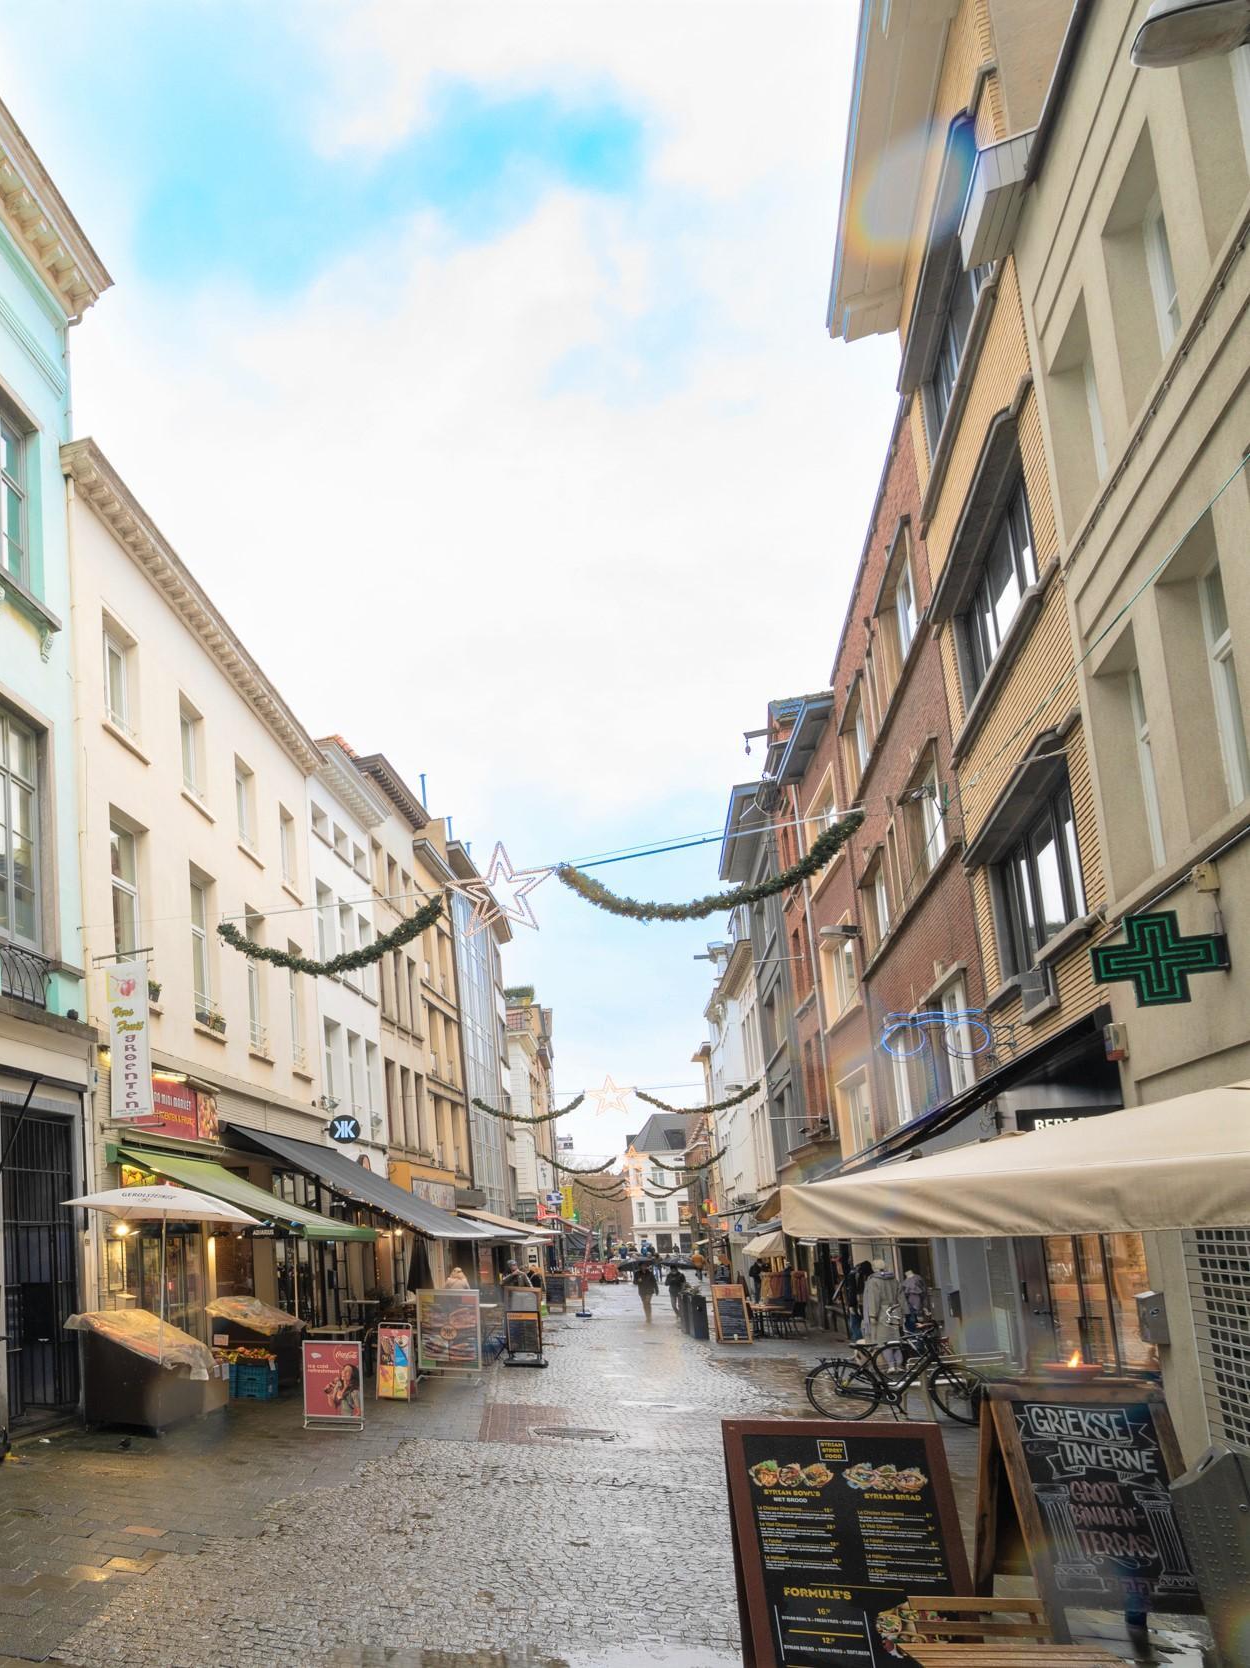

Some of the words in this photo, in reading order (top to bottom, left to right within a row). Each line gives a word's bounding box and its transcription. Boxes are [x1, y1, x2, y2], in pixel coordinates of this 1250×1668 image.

[1059, 1441, 1159, 1474] TAVERNE
[1069, 1480, 1124, 1504] GROOT
[1076, 1529, 1159, 1560] TERRAS
[783, 1586, 852, 1600] FORMULE'S
